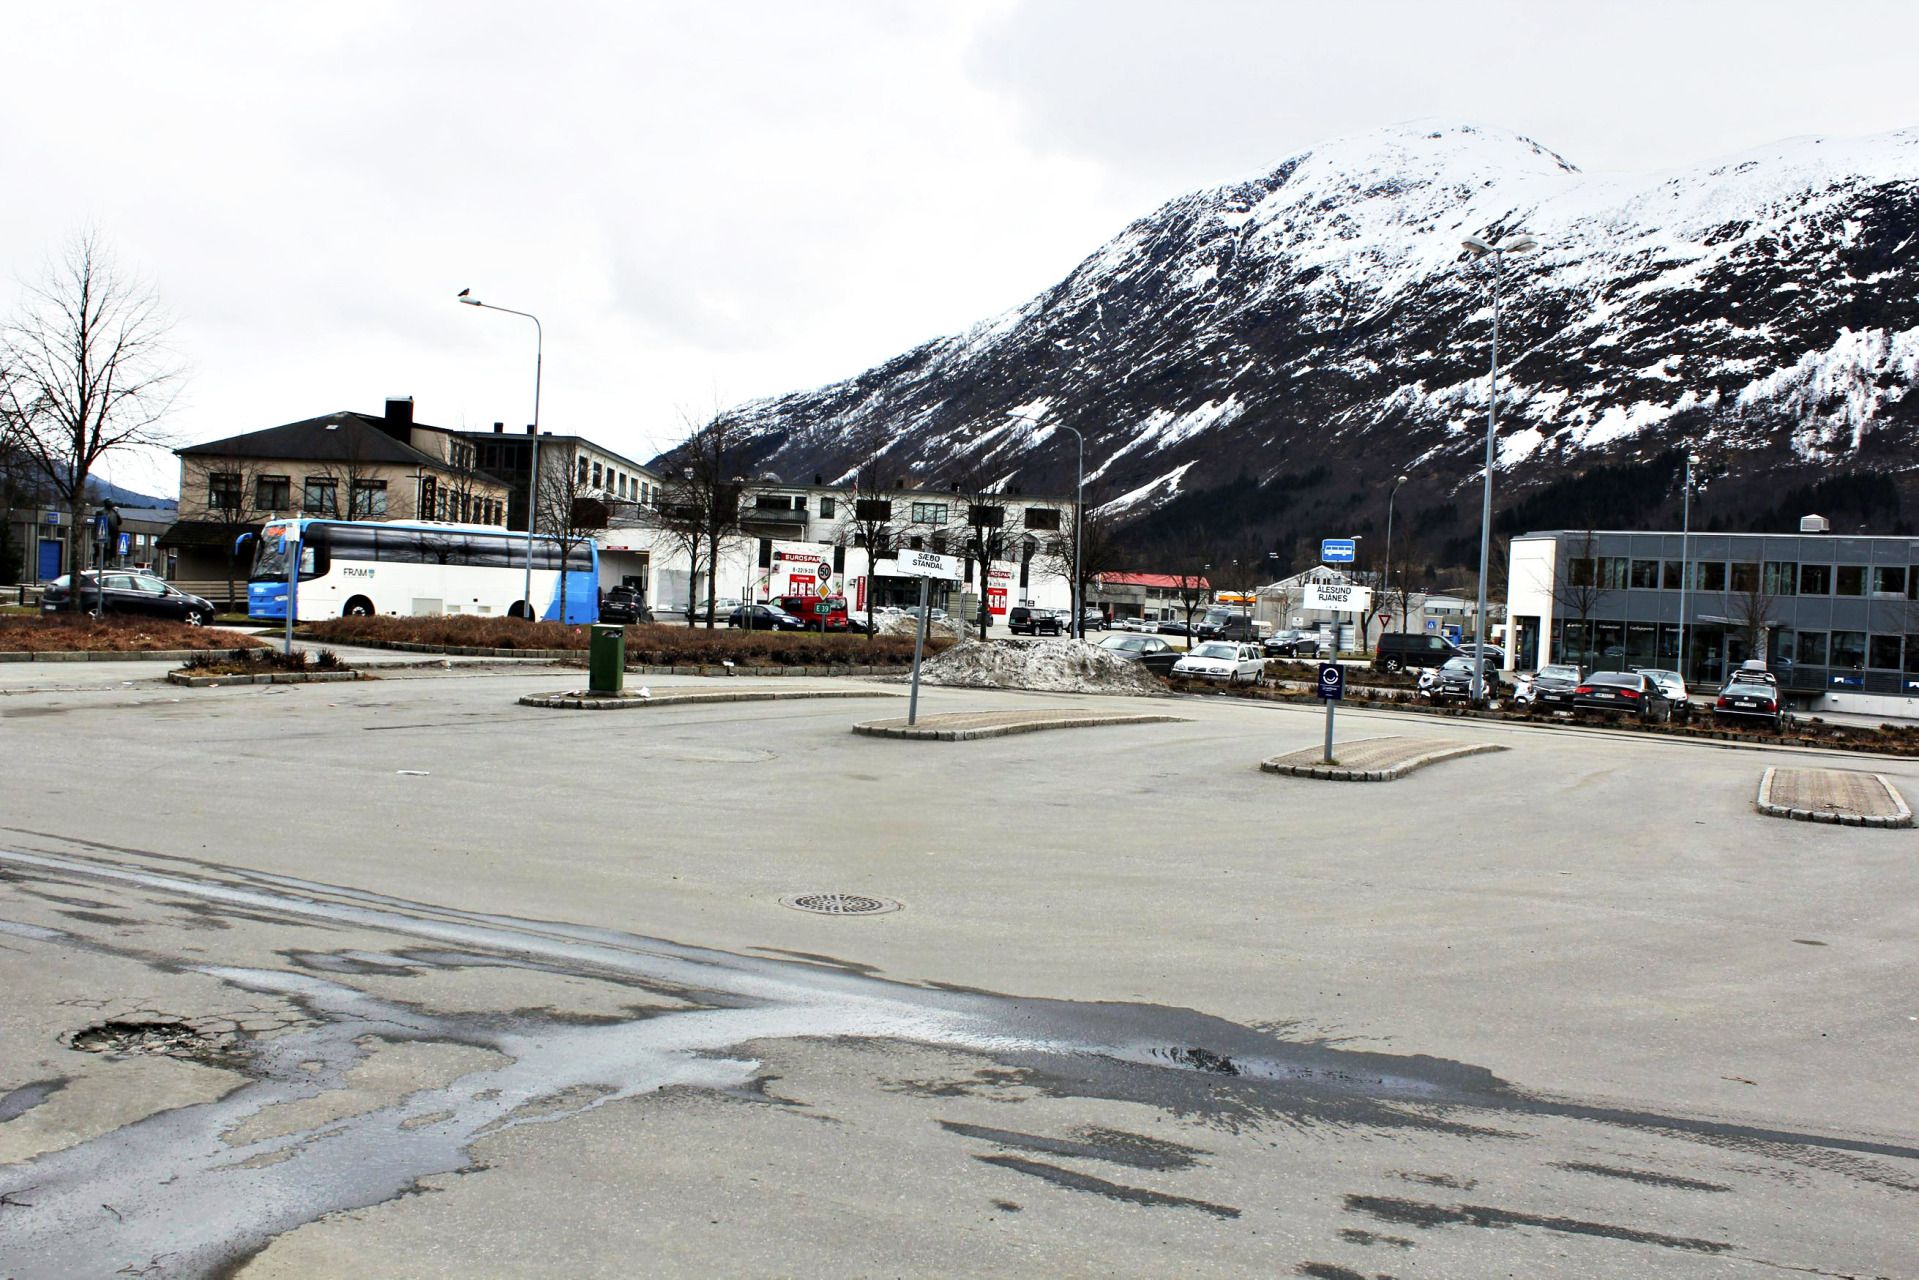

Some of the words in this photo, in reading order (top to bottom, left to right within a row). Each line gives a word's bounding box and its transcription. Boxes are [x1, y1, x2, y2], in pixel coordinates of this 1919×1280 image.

[785, 554, 821, 563] EUROSPAR
[918, 553, 941, 562] SÆBØ
[912, 559, 944, 570] STANDAL
[343, 568, 367, 576] FRAM
[820, 567, 829, 577] 50
